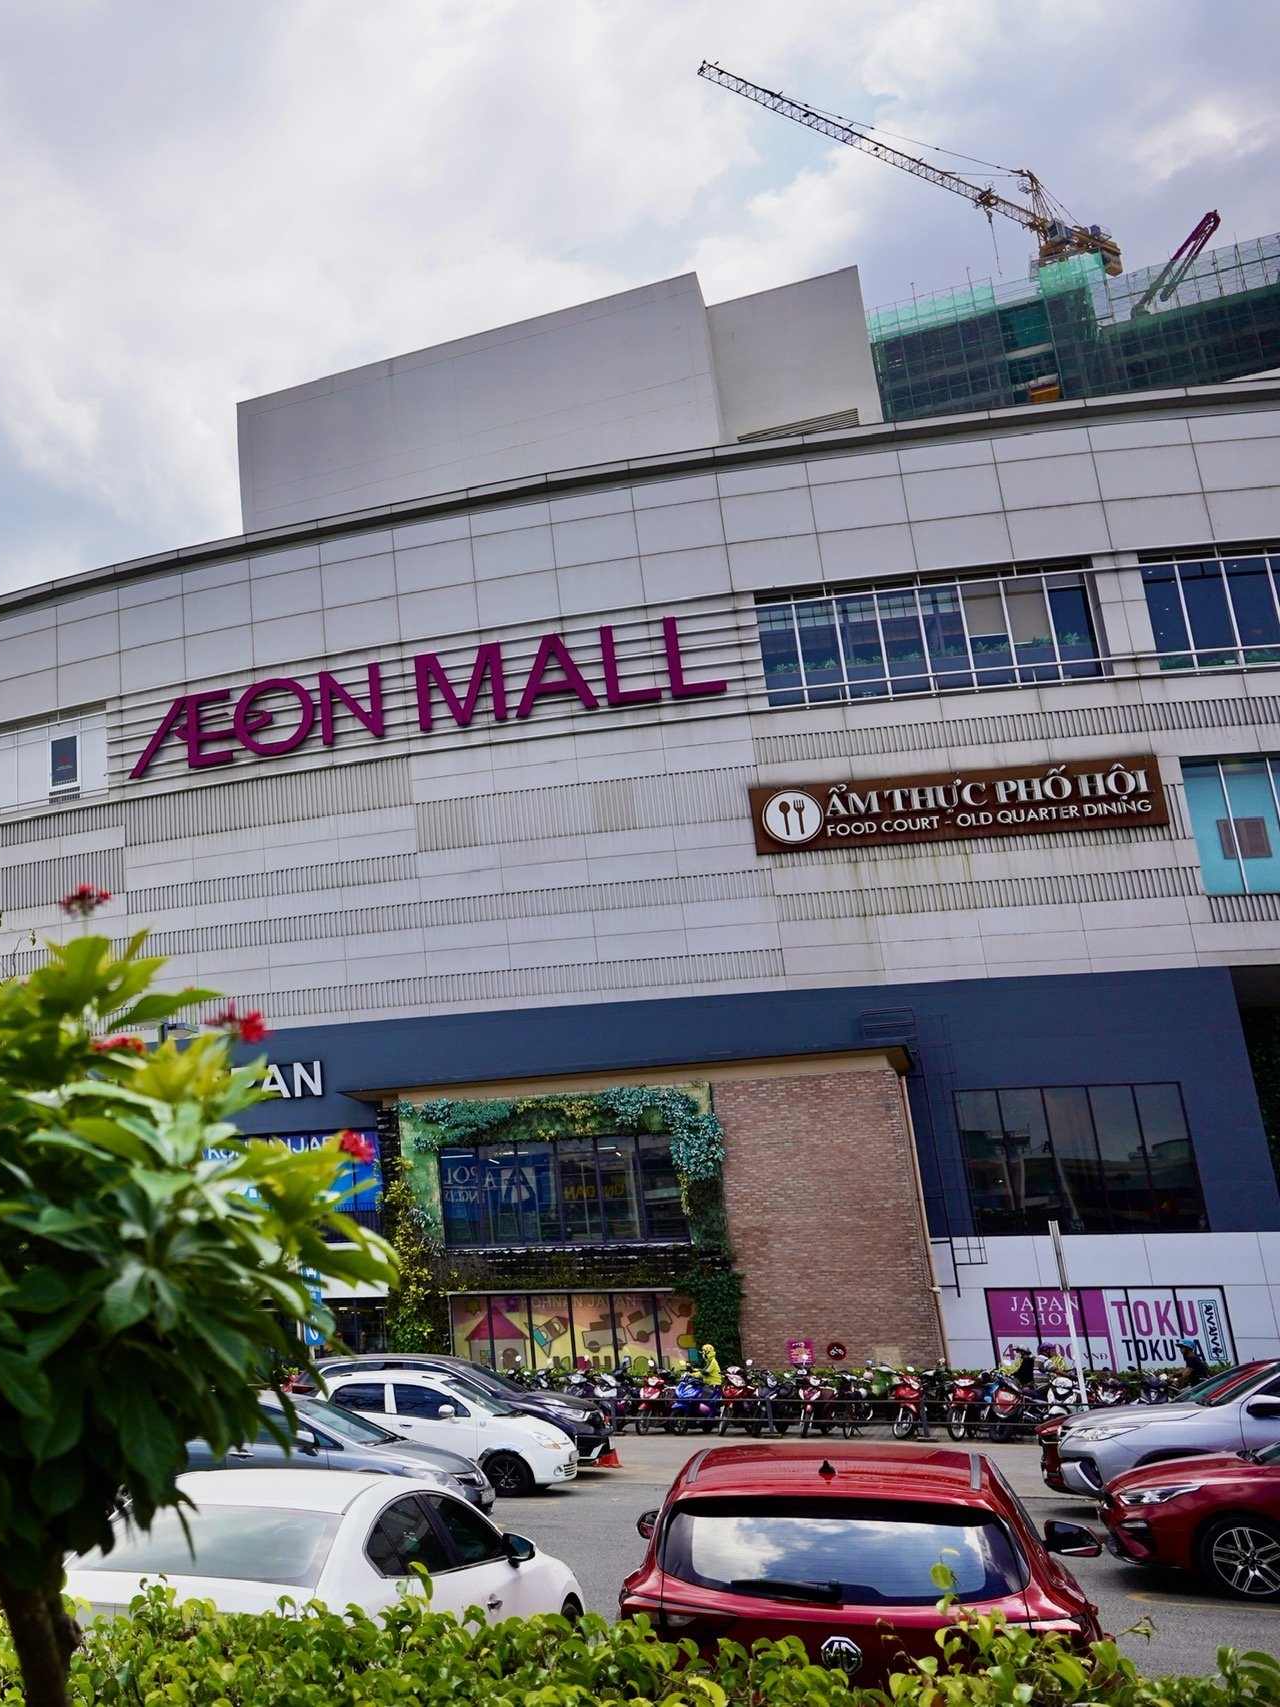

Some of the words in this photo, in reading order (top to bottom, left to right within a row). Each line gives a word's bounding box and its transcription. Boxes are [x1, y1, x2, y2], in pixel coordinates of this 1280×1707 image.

[413, 615, 728, 733] MALL
[824, 783, 882, 817] ẨM
[883, 778, 989, 815] THỰC
[992, 764, 1072, 804] PHỐ
[1074, 763, 1155, 801] HỘI
[826, 821, 877, 837] FOOD
[880, 815, 940, 833] COURT
[955, 811, 993, 827] OLD
[996, 804, 1081, 825] QUARTER
[1083, 800, 1153, 818] DINING
[1010, 1296, 1079, 1312] JAPAN
[1111, 1300, 1199, 1337] TOKU
[1121, 1338, 1208, 1362] TOKUA
